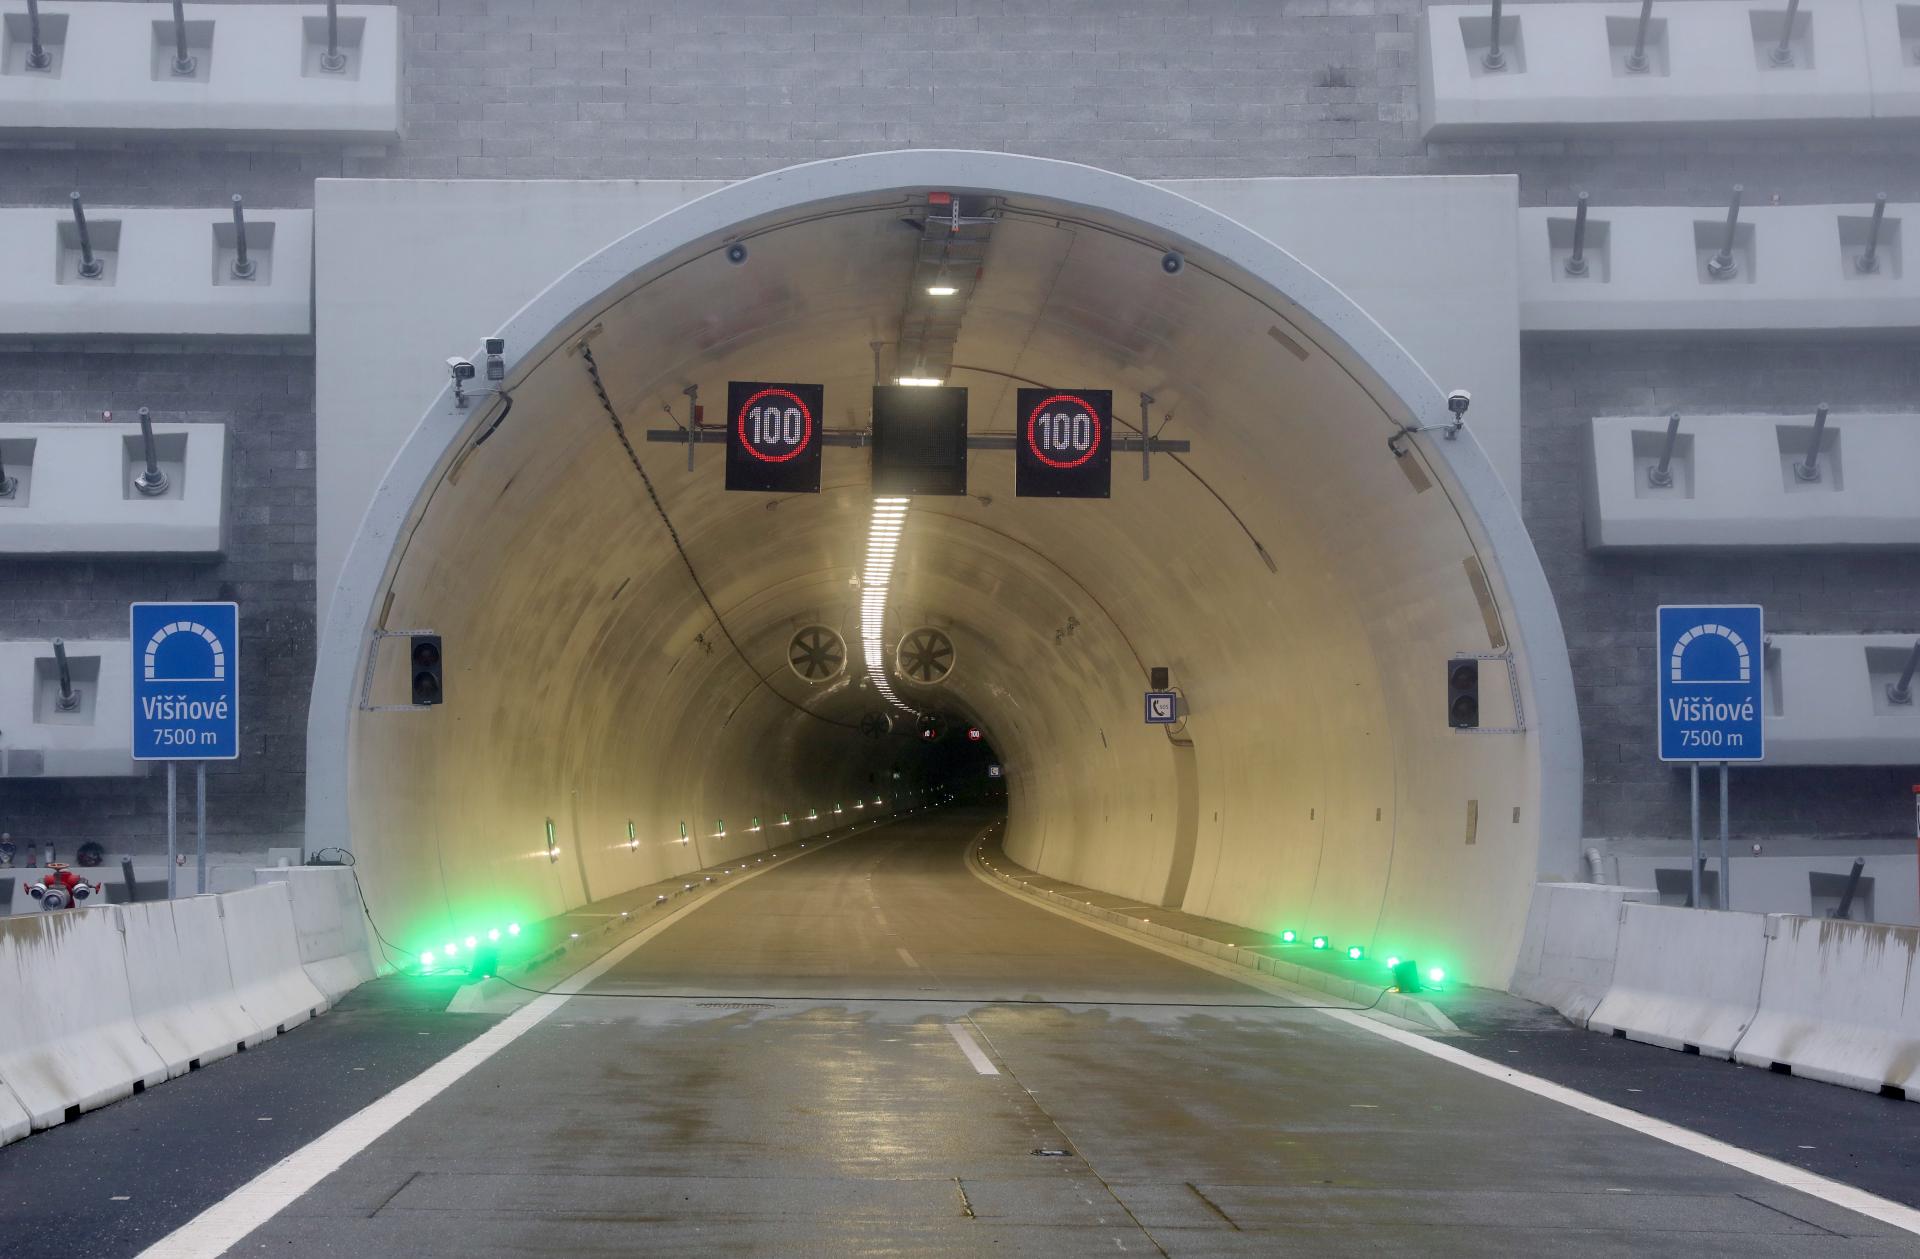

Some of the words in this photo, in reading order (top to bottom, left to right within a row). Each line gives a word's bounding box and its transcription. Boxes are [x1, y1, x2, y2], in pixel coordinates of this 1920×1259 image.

[749, 406, 801, 444] 100
[1038, 413, 1090, 450] 100
[142, 695, 228, 720] Višňové
[1669, 697, 1754, 721] Višňové
[153, 728, 196, 745] 7500
[201, 732, 217, 745] m
[1680, 730, 1723, 746] 7500
[1727, 734, 1743, 746] m
